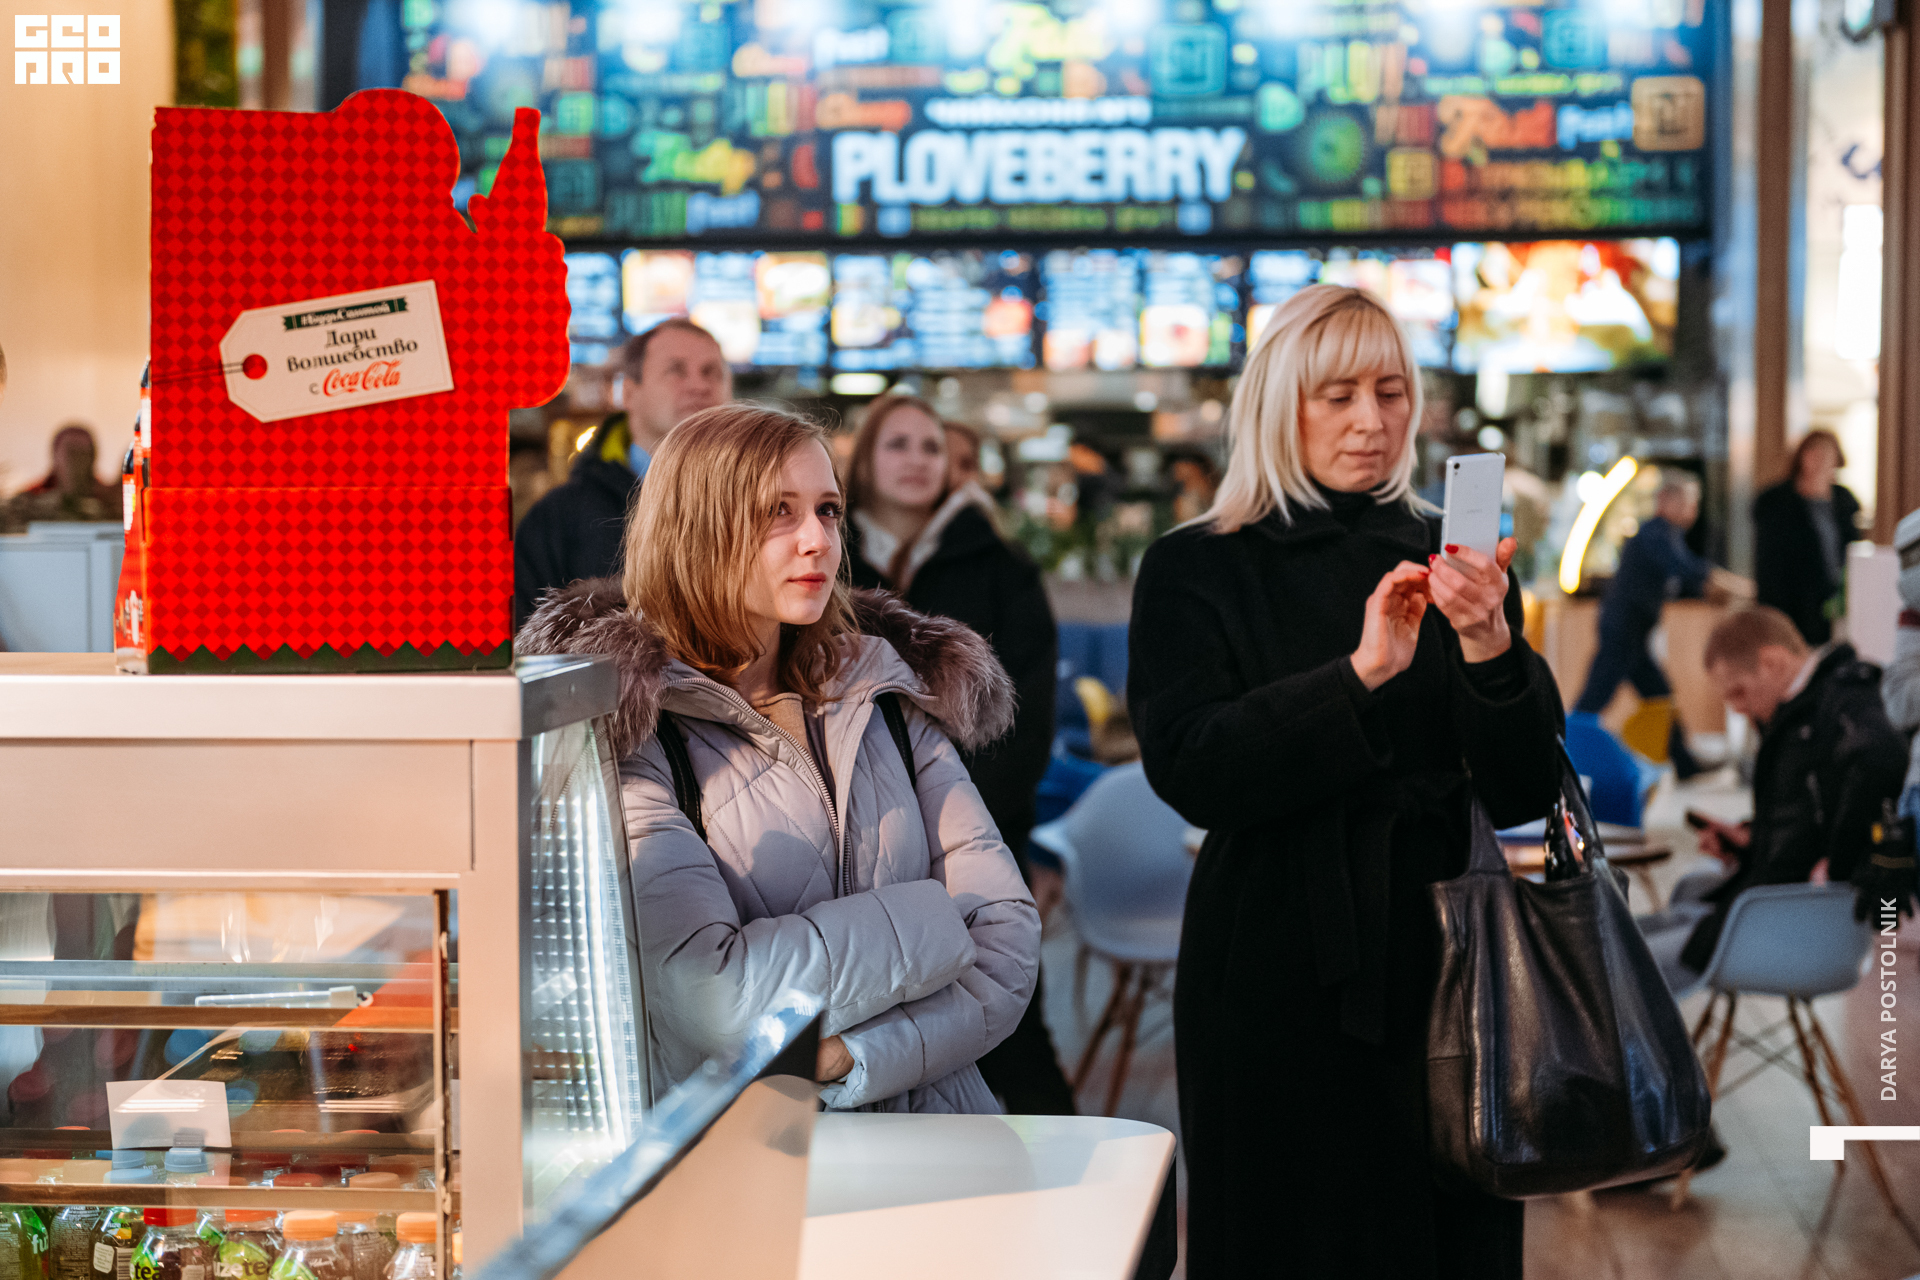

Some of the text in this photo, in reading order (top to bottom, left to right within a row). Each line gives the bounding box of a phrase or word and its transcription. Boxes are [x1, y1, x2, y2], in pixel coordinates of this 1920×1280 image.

[832, 127, 1246, 205] PLOVEBERRY
[324, 327, 378, 349] Дари
[309, 382, 320, 395] с
